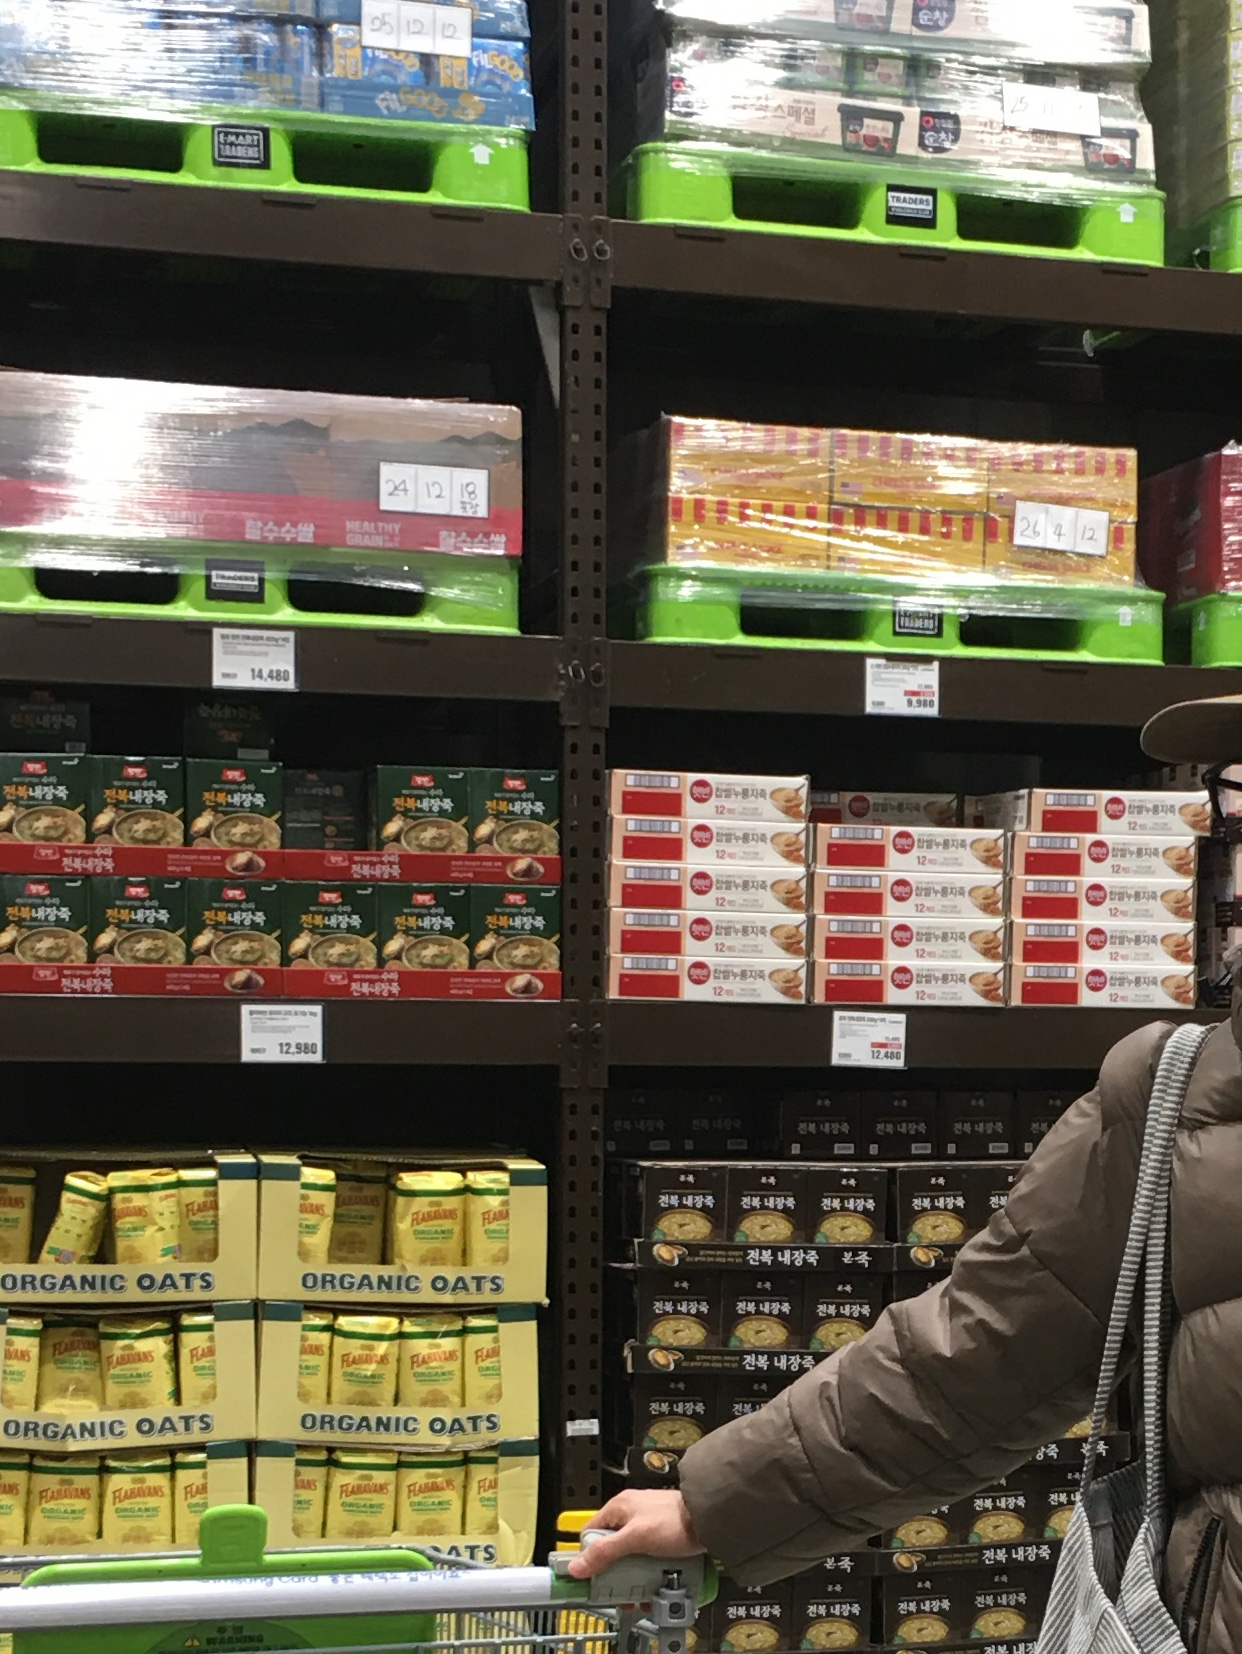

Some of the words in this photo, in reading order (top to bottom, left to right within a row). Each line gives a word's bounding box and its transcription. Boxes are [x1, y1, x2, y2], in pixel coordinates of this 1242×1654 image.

[370, 12, 394, 36] 25
[405, 18, 425, 35] 12
[890, 195, 931, 208] TRADERS
[384, 478, 410, 498] 24
[425, 481, 446, 500] 12
[459, 481, 478, 500] 18
[345, 520, 401, 534] HEALTHY
[1019, 516, 1041, 540] 26
[1052, 522, 1067, 544] 4
[1080, 524, 1098, 542] 12
[249, 667, 291, 682] 14,480
[3, 784, 69, 802] 전복내장죽
[103, 787, 169, 806] 전복내장죽
[202, 789, 267, 808] 전복내장죽
[392, 795, 455, 813] 전복내장죽
[485, 798, 546, 817] 전복내장죽
[5, 905, 72, 923] 전복내장죽
[105, 907, 171, 925] 전복내장죽
[202, 908, 267, 927] 전복내장죽
[299, 912, 363, 930] 전복내장죽
[393, 914, 456, 932] 전복내장죽
[485, 912, 547, 932] 전복내장죽
[278, 1041, 319, 1055] 12,980
[870, 1049, 902, 1061] 12,480
[657, 1194, 681, 1209] 전복
[682, 1193, 716, 1208] 내장죽
[740, 1195, 761, 1210] 전복
[763, 1195, 797, 1210] 내장죽
[820, 1197, 842, 1212] 전복
[843, 1197, 876, 1212] 내장죽
[911, 1196, 933, 1211] 전복
[934, 1195, 966, 1210] 내장죽
[745, 1248, 774, 1267] 전복
[777, 1248, 820, 1267] 내장죽
[841, 1250, 873, 1268] 본죽
[1, 1272, 128, 1294] ORGANIC
[136, 1271, 215, 1293] OATS
[301, 1271, 422, 1294] ORGANIC
[429, 1274, 505, 1296] OATS
[652, 1300, 674, 1315] 전복
[676, 1300, 710, 1315] 내장죽
[735, 1300, 757, 1315] 전복
[758, 1300, 792, 1315] 내장죽
[815, 1303, 838, 1318] 전복
[839, 1303, 872, 1318] 내장죽
[741, 1353, 770, 1371] 전복
[773, 1353, 816, 1371] 내장죽
[3, 1417, 128, 1441] ORGANIC
[135, 1413, 214, 1437] OATS
[300, 1412, 421, 1435] ORGANIC
[428, 1412, 501, 1436] OATS
[973, 1497, 994, 1511] 전복
[996, 1495, 1027, 1510] 내장죽
[981, 1548, 1009, 1566] 전복
[1011, 1544, 1052, 1562] 내장죽
[823, 1556, 855, 1574] 본죽
[726, 1605, 748, 1619] 전복
[749, 1604, 782, 1618] 내장죽
[806, 1604, 828, 1618] 전복
[830, 1603, 862, 1618] 내장죽
[897, 1600, 918, 1615] 전복
[920, 1599, 952, 1613] 내장죽
